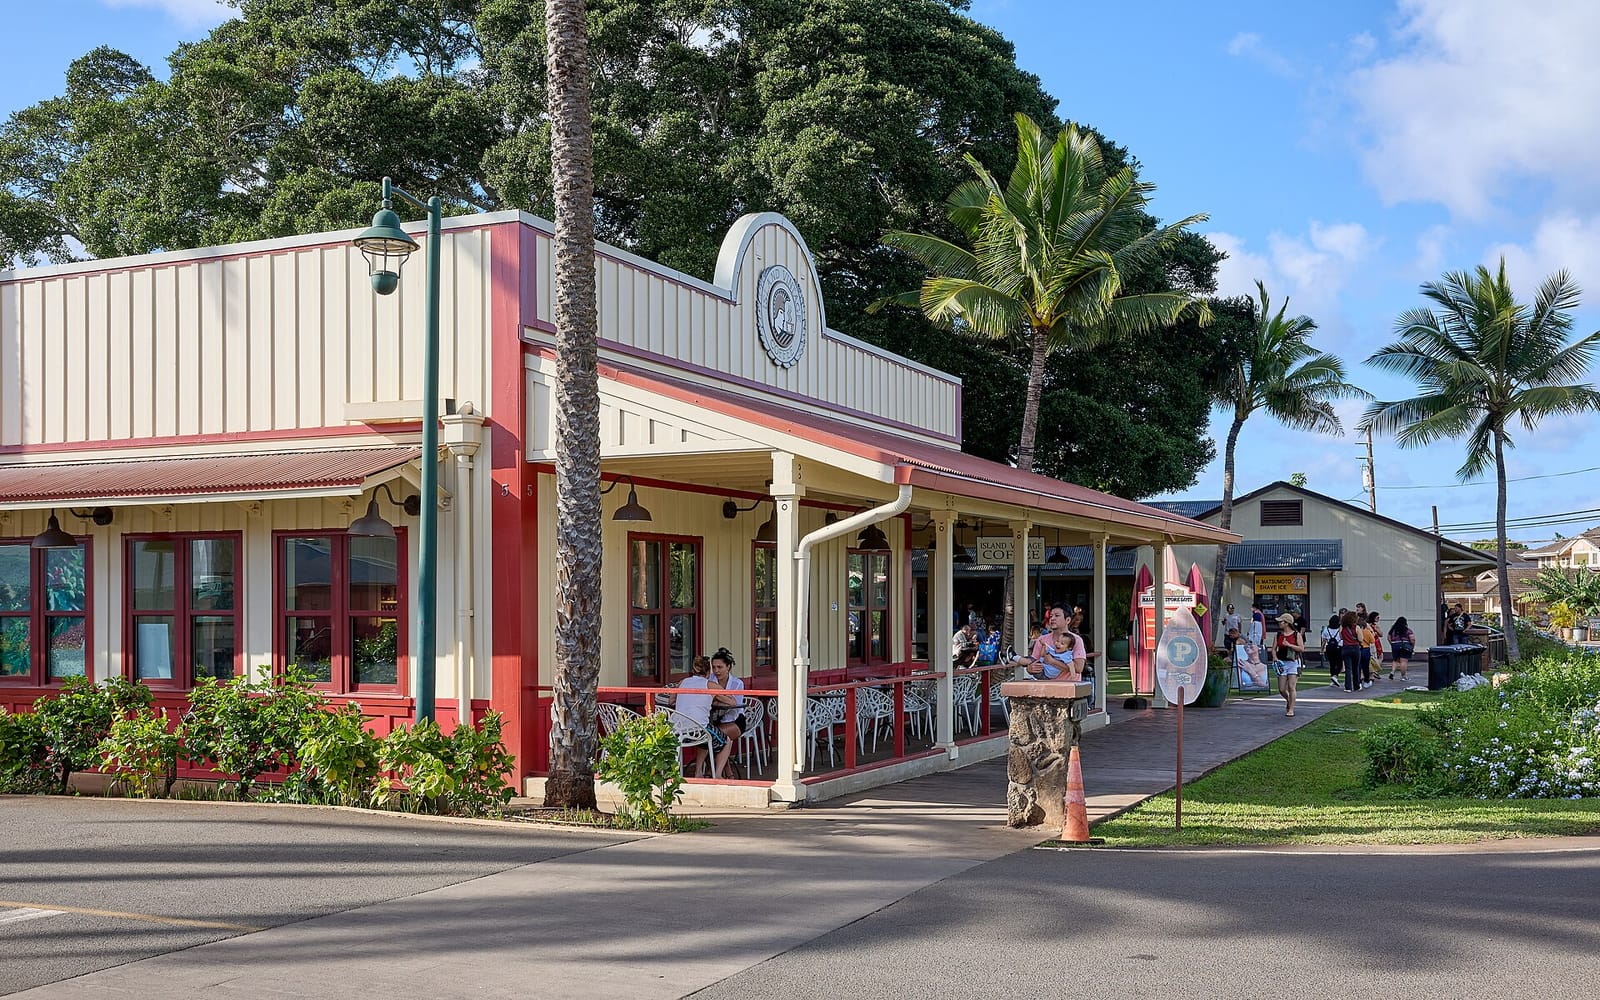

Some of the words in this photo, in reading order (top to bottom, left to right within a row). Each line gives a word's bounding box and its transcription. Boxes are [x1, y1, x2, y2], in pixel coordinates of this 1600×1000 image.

[501, 484, 509, 497] 5
[527, 485, 533, 497] 5
[1174, 642, 1192, 662] P
